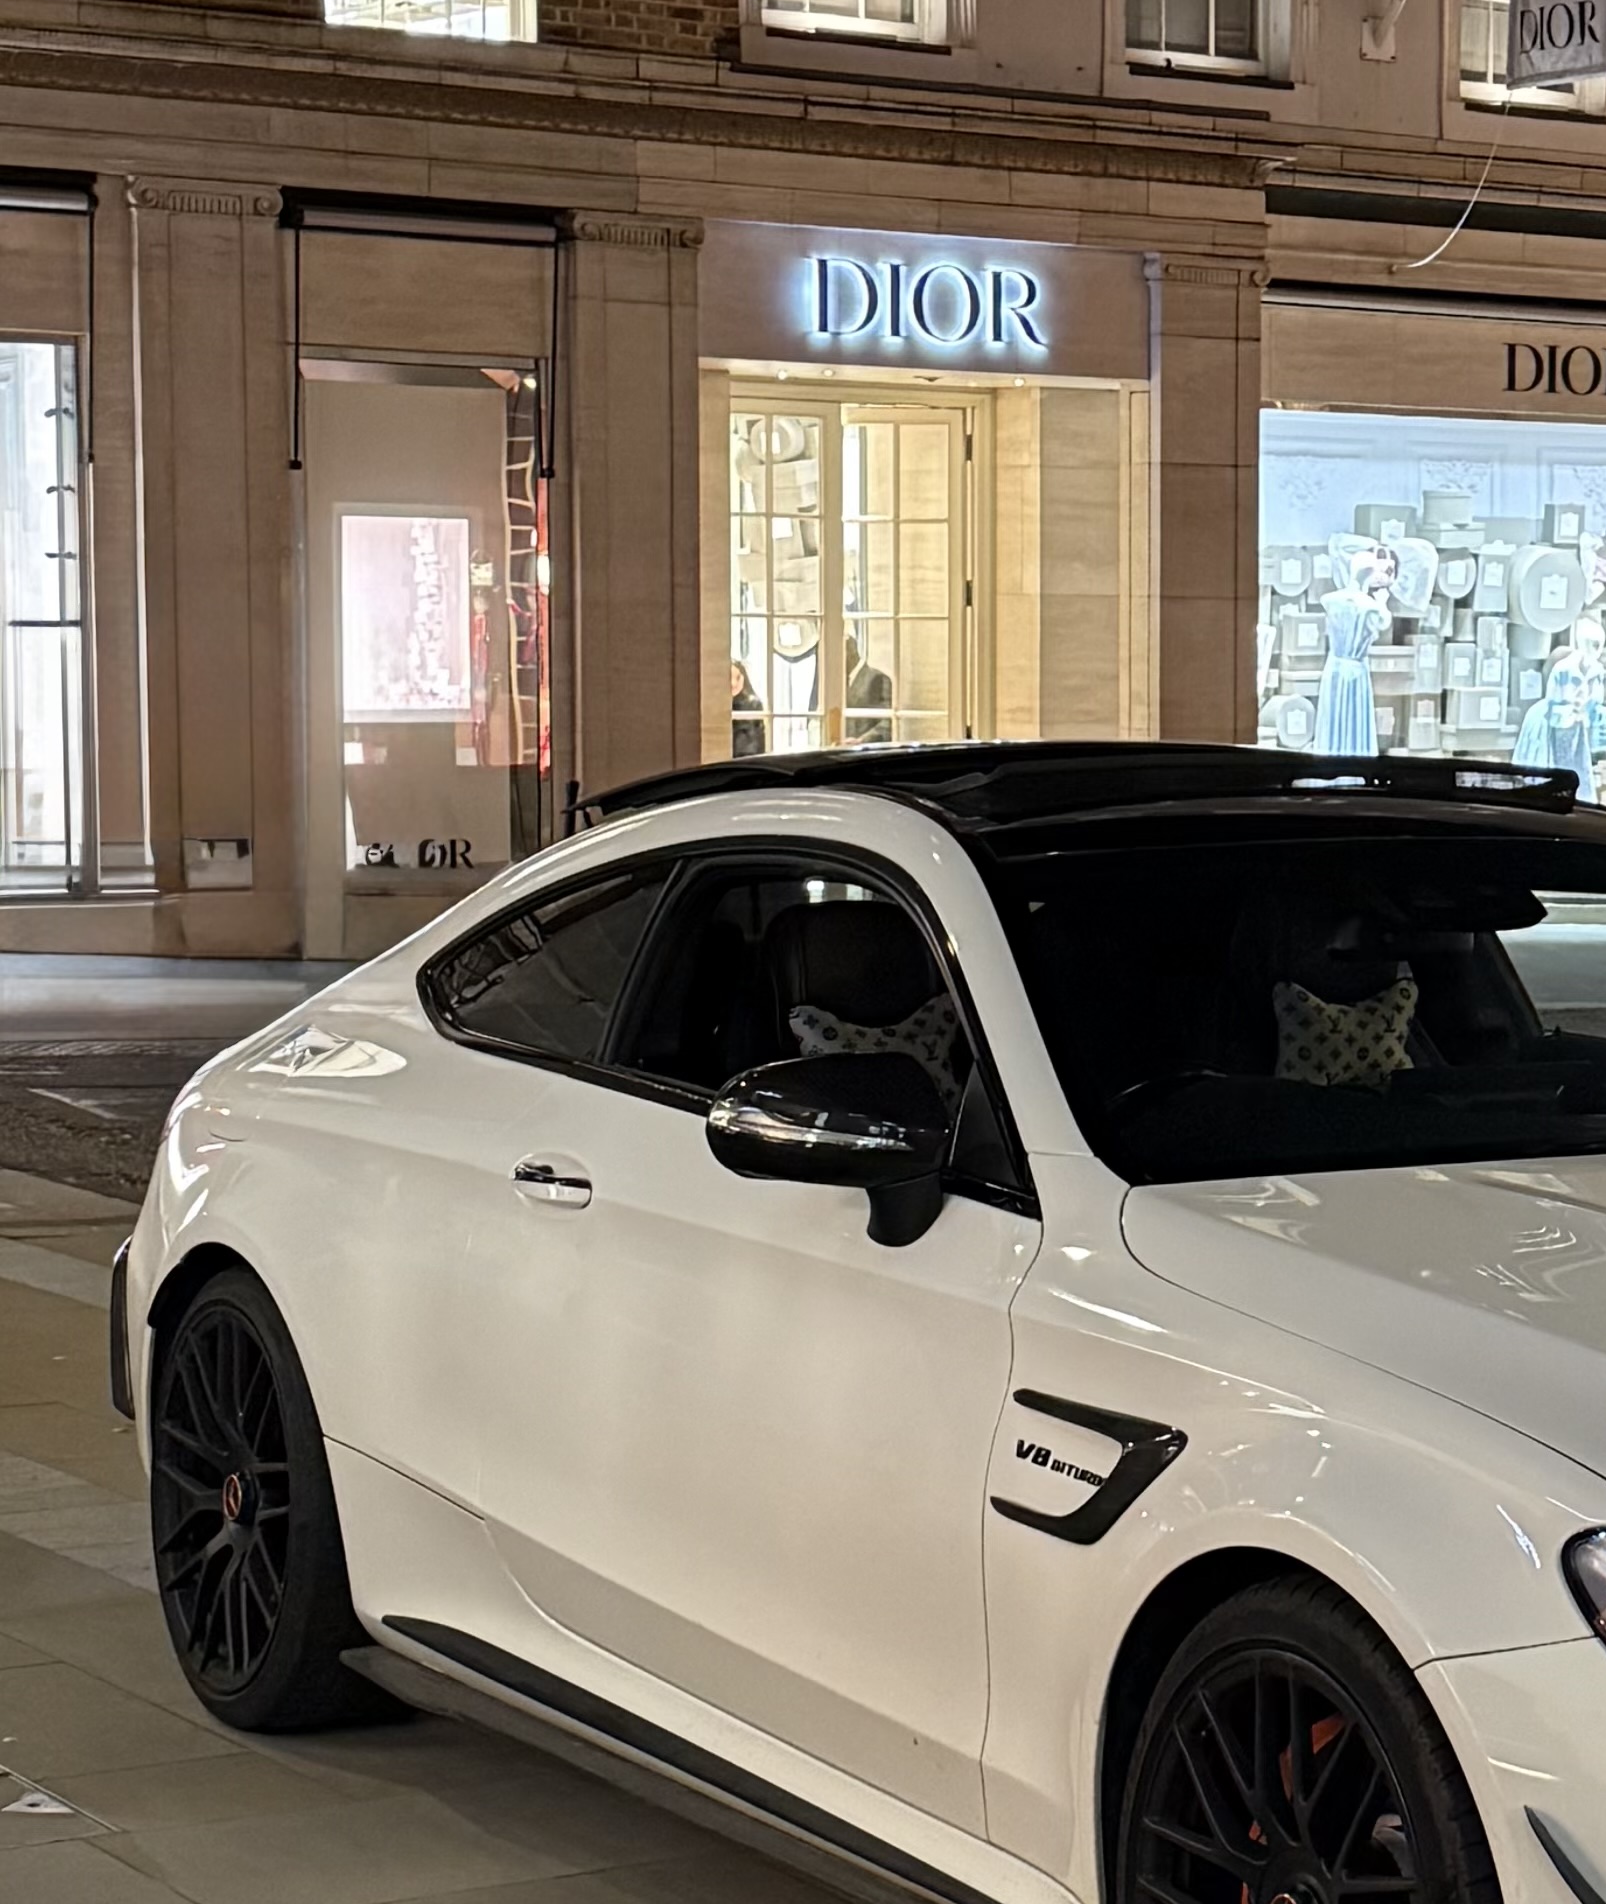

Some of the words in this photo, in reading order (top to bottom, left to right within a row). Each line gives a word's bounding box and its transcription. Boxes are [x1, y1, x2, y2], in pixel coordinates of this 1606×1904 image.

[1520, 0, 1600, 56] DIOR
[806, 255, 1048, 346] DIOR
[1015, 1439, 1052, 1467] V8
